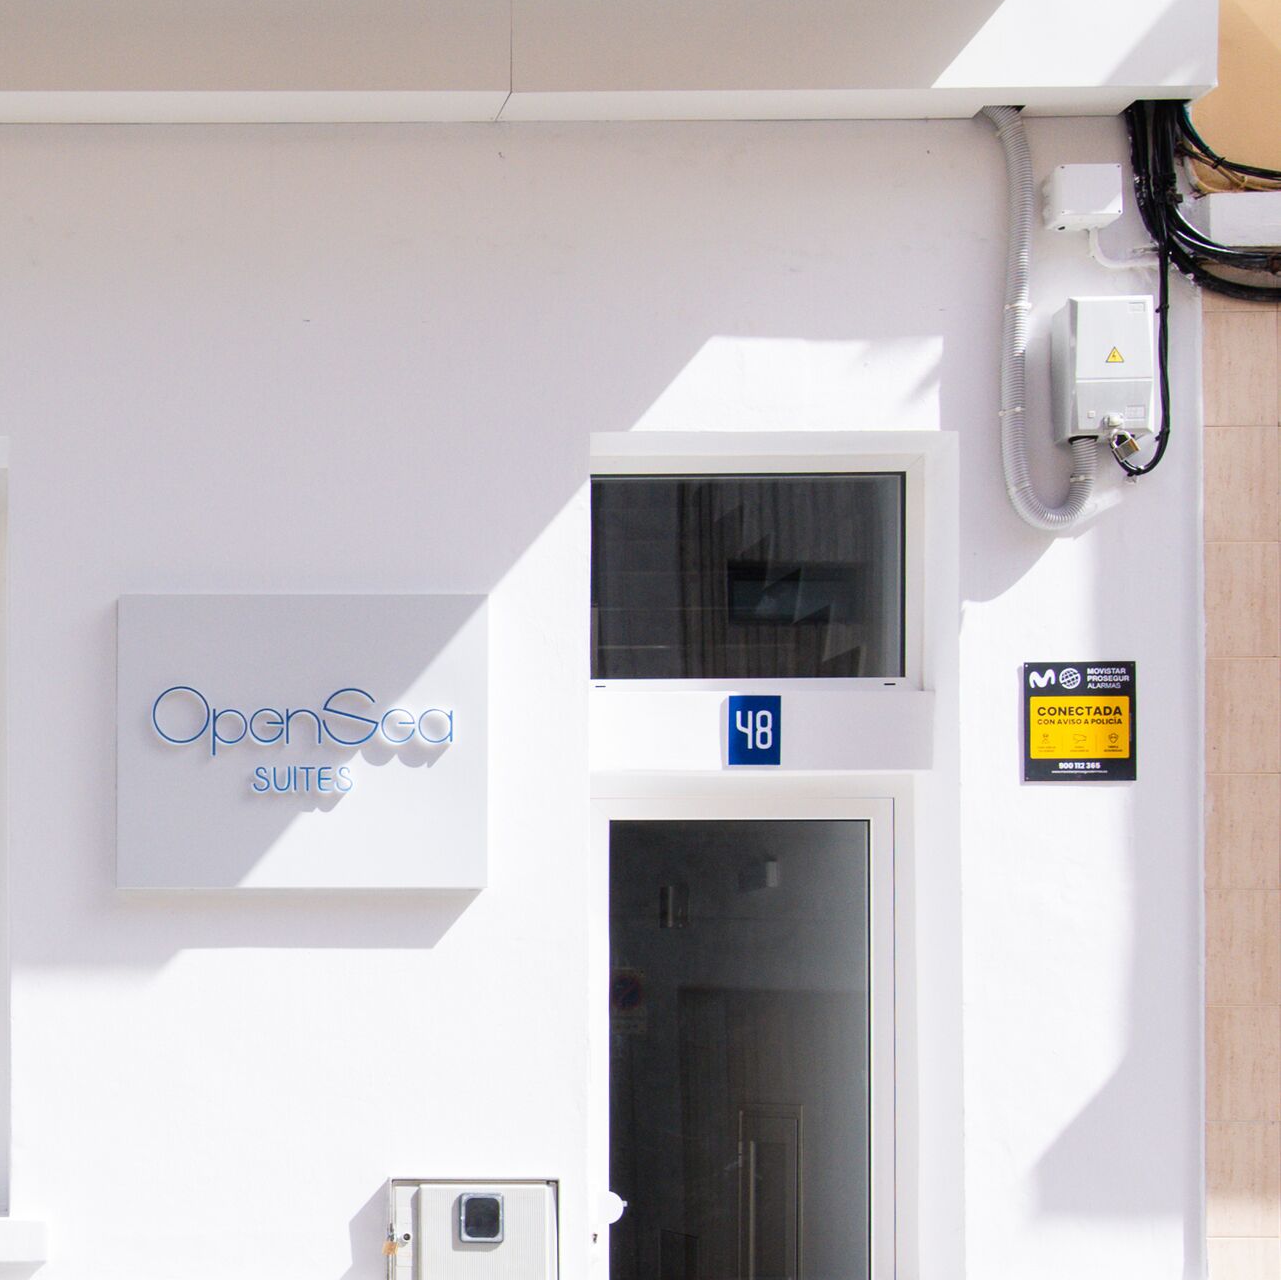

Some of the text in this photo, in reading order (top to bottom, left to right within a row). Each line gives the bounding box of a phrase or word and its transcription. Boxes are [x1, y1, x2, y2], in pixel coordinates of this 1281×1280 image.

[152, 685, 454, 756] OpenSea
[1037, 706, 1123, 716] CONECTADA
[1091, 717, 1123, 725] POLICÍA
[736, 709, 773, 750] 48
[252, 766, 354, 792] SUITES
